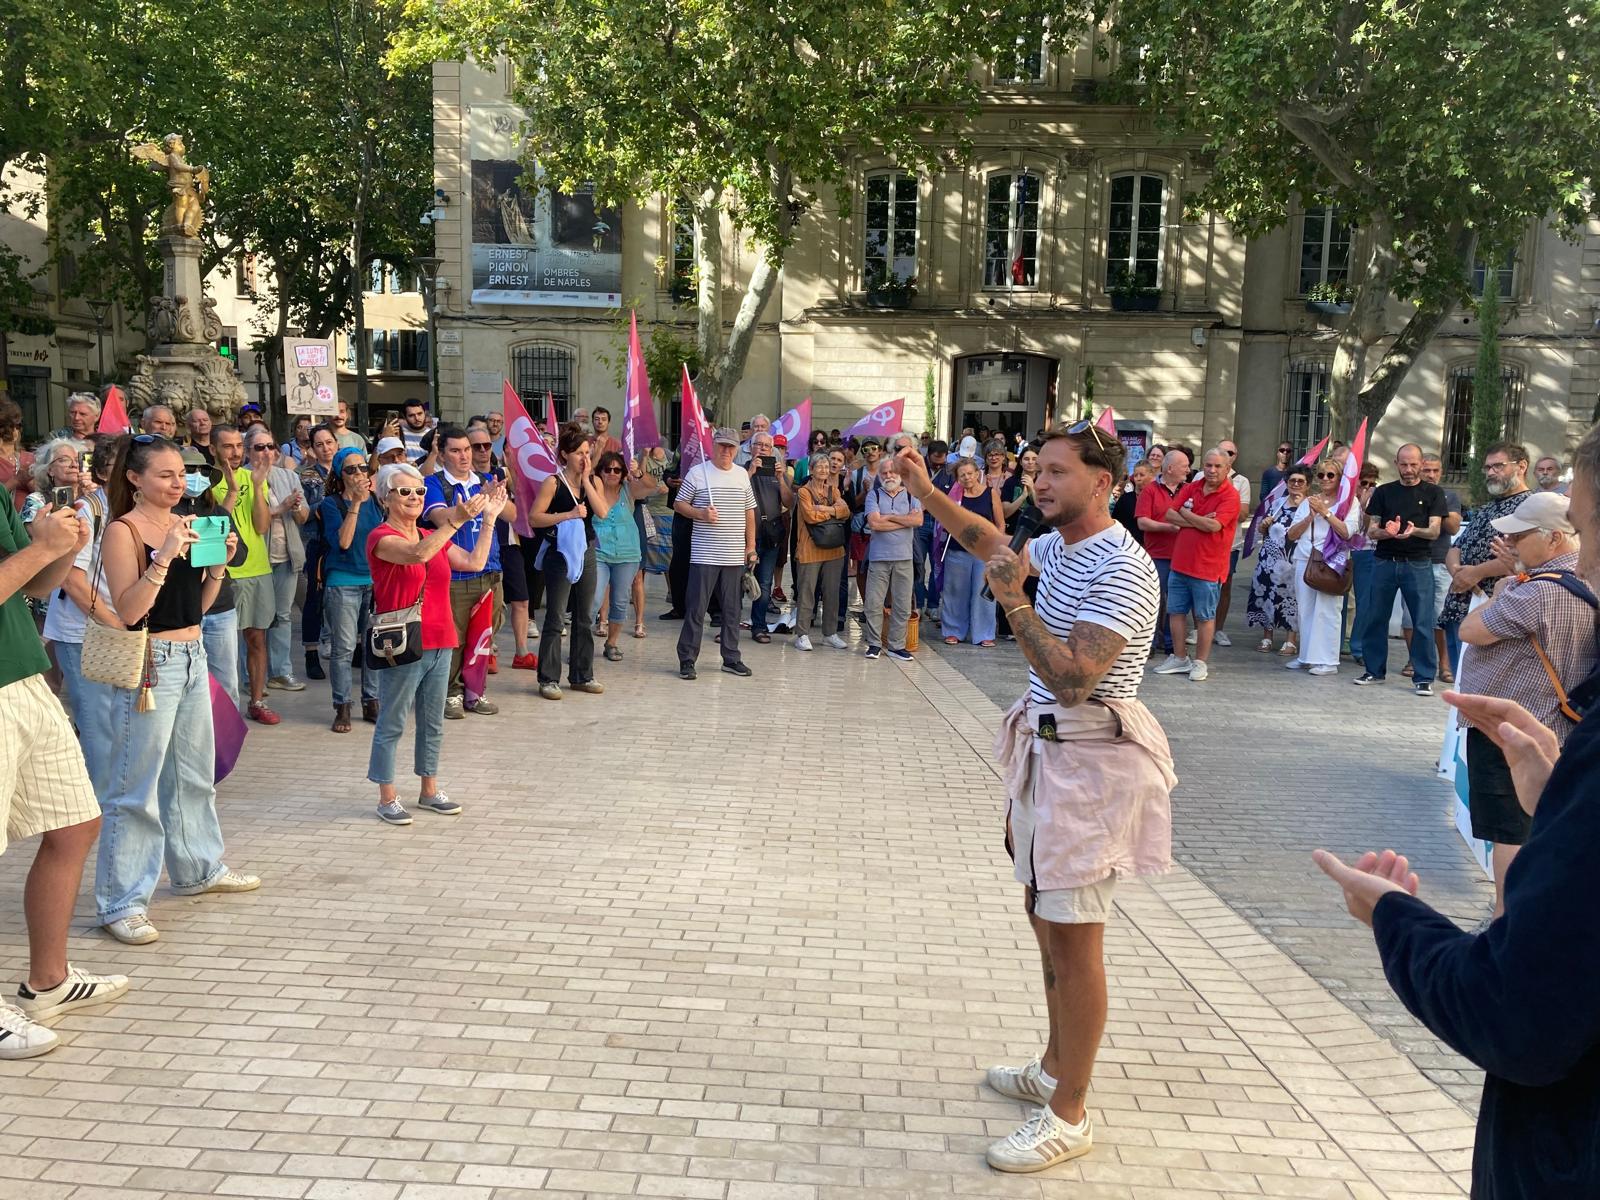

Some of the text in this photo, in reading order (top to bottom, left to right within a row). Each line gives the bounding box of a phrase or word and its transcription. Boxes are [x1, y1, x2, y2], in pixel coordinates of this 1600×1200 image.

[488, 249, 529, 259] ERNEST
[488, 262, 529, 273] PIGNON
[543, 268, 580, 277] OMBRES
[488, 275, 529, 286] ERNEST
[543, 278, 592, 287] DE NAPLES
